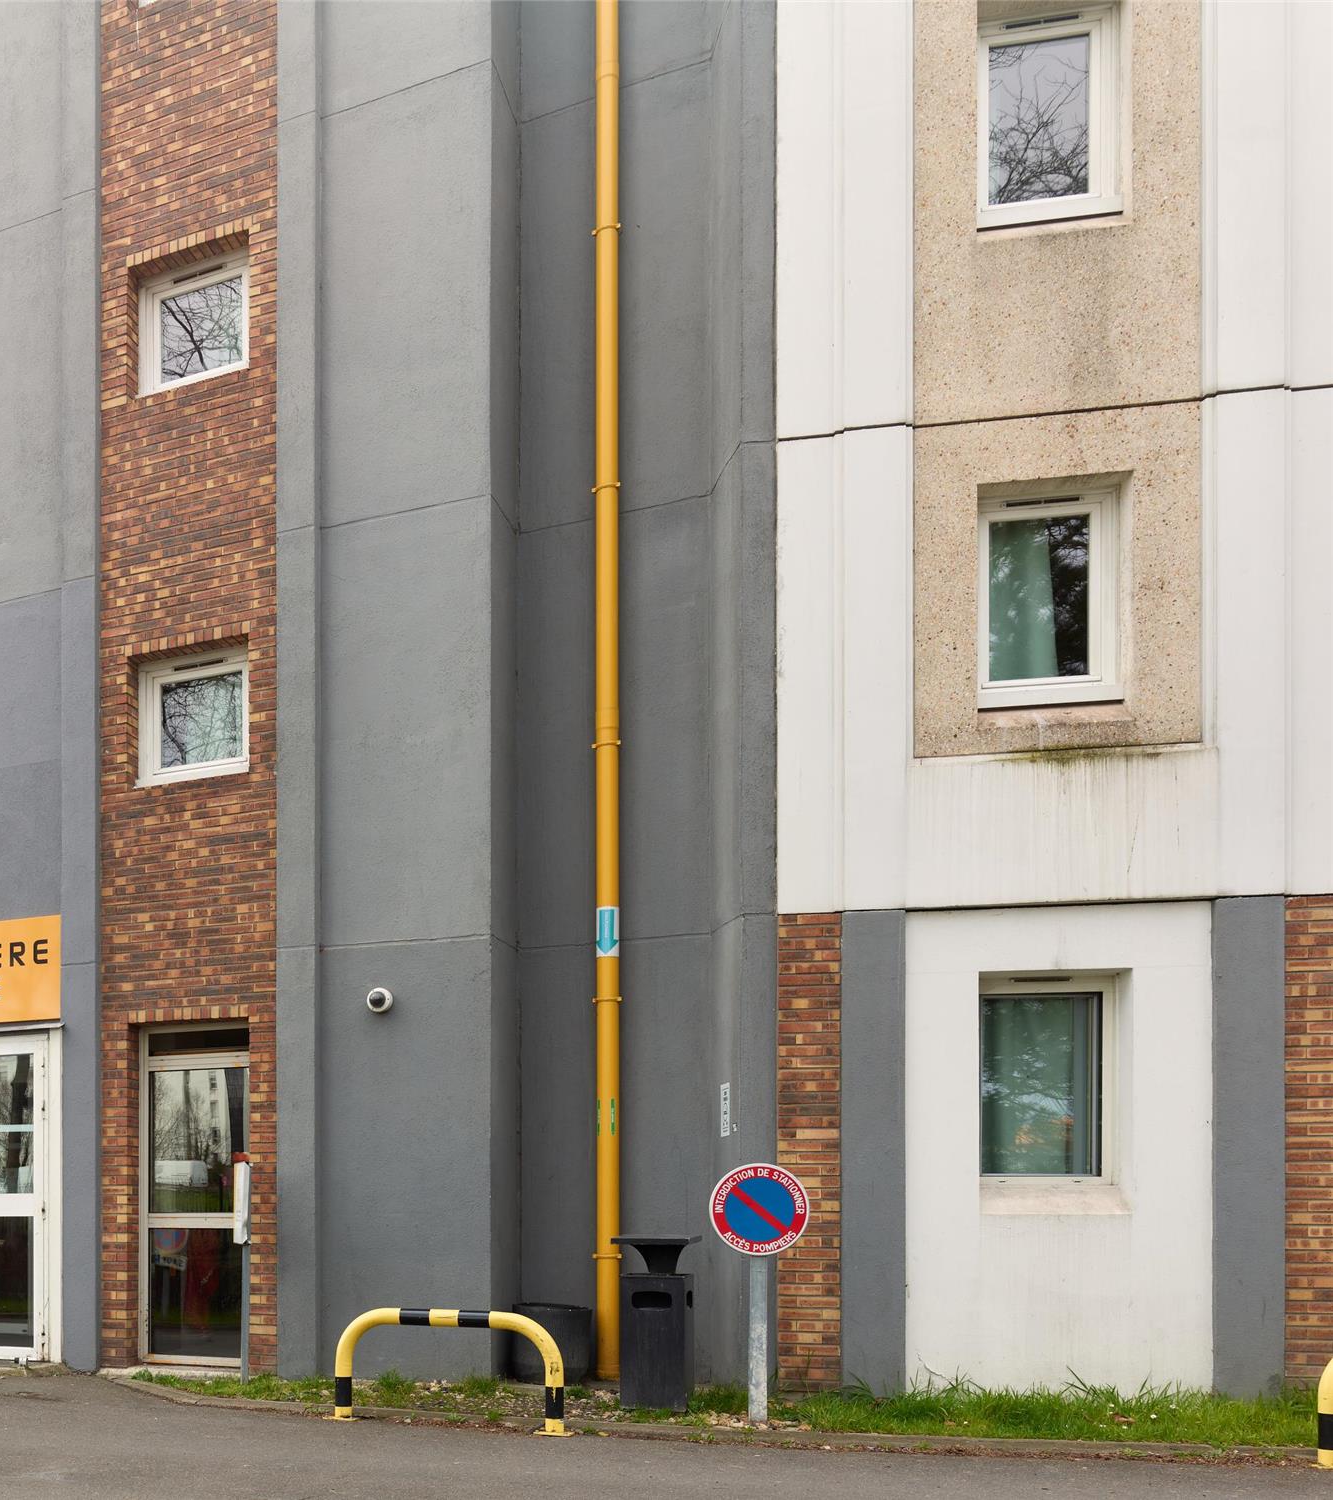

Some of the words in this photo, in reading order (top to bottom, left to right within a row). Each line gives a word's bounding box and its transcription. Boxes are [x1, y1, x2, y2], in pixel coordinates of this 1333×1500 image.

[714, 1169, 755, 1214] INTERDICTION
[757, 1168, 770, 1177] DE
[772, 1171, 805, 1215] STATIONNER
[723, 1231, 751, 1251] ACCÈS
[753, 1231, 797, 1252] POMPIERS
